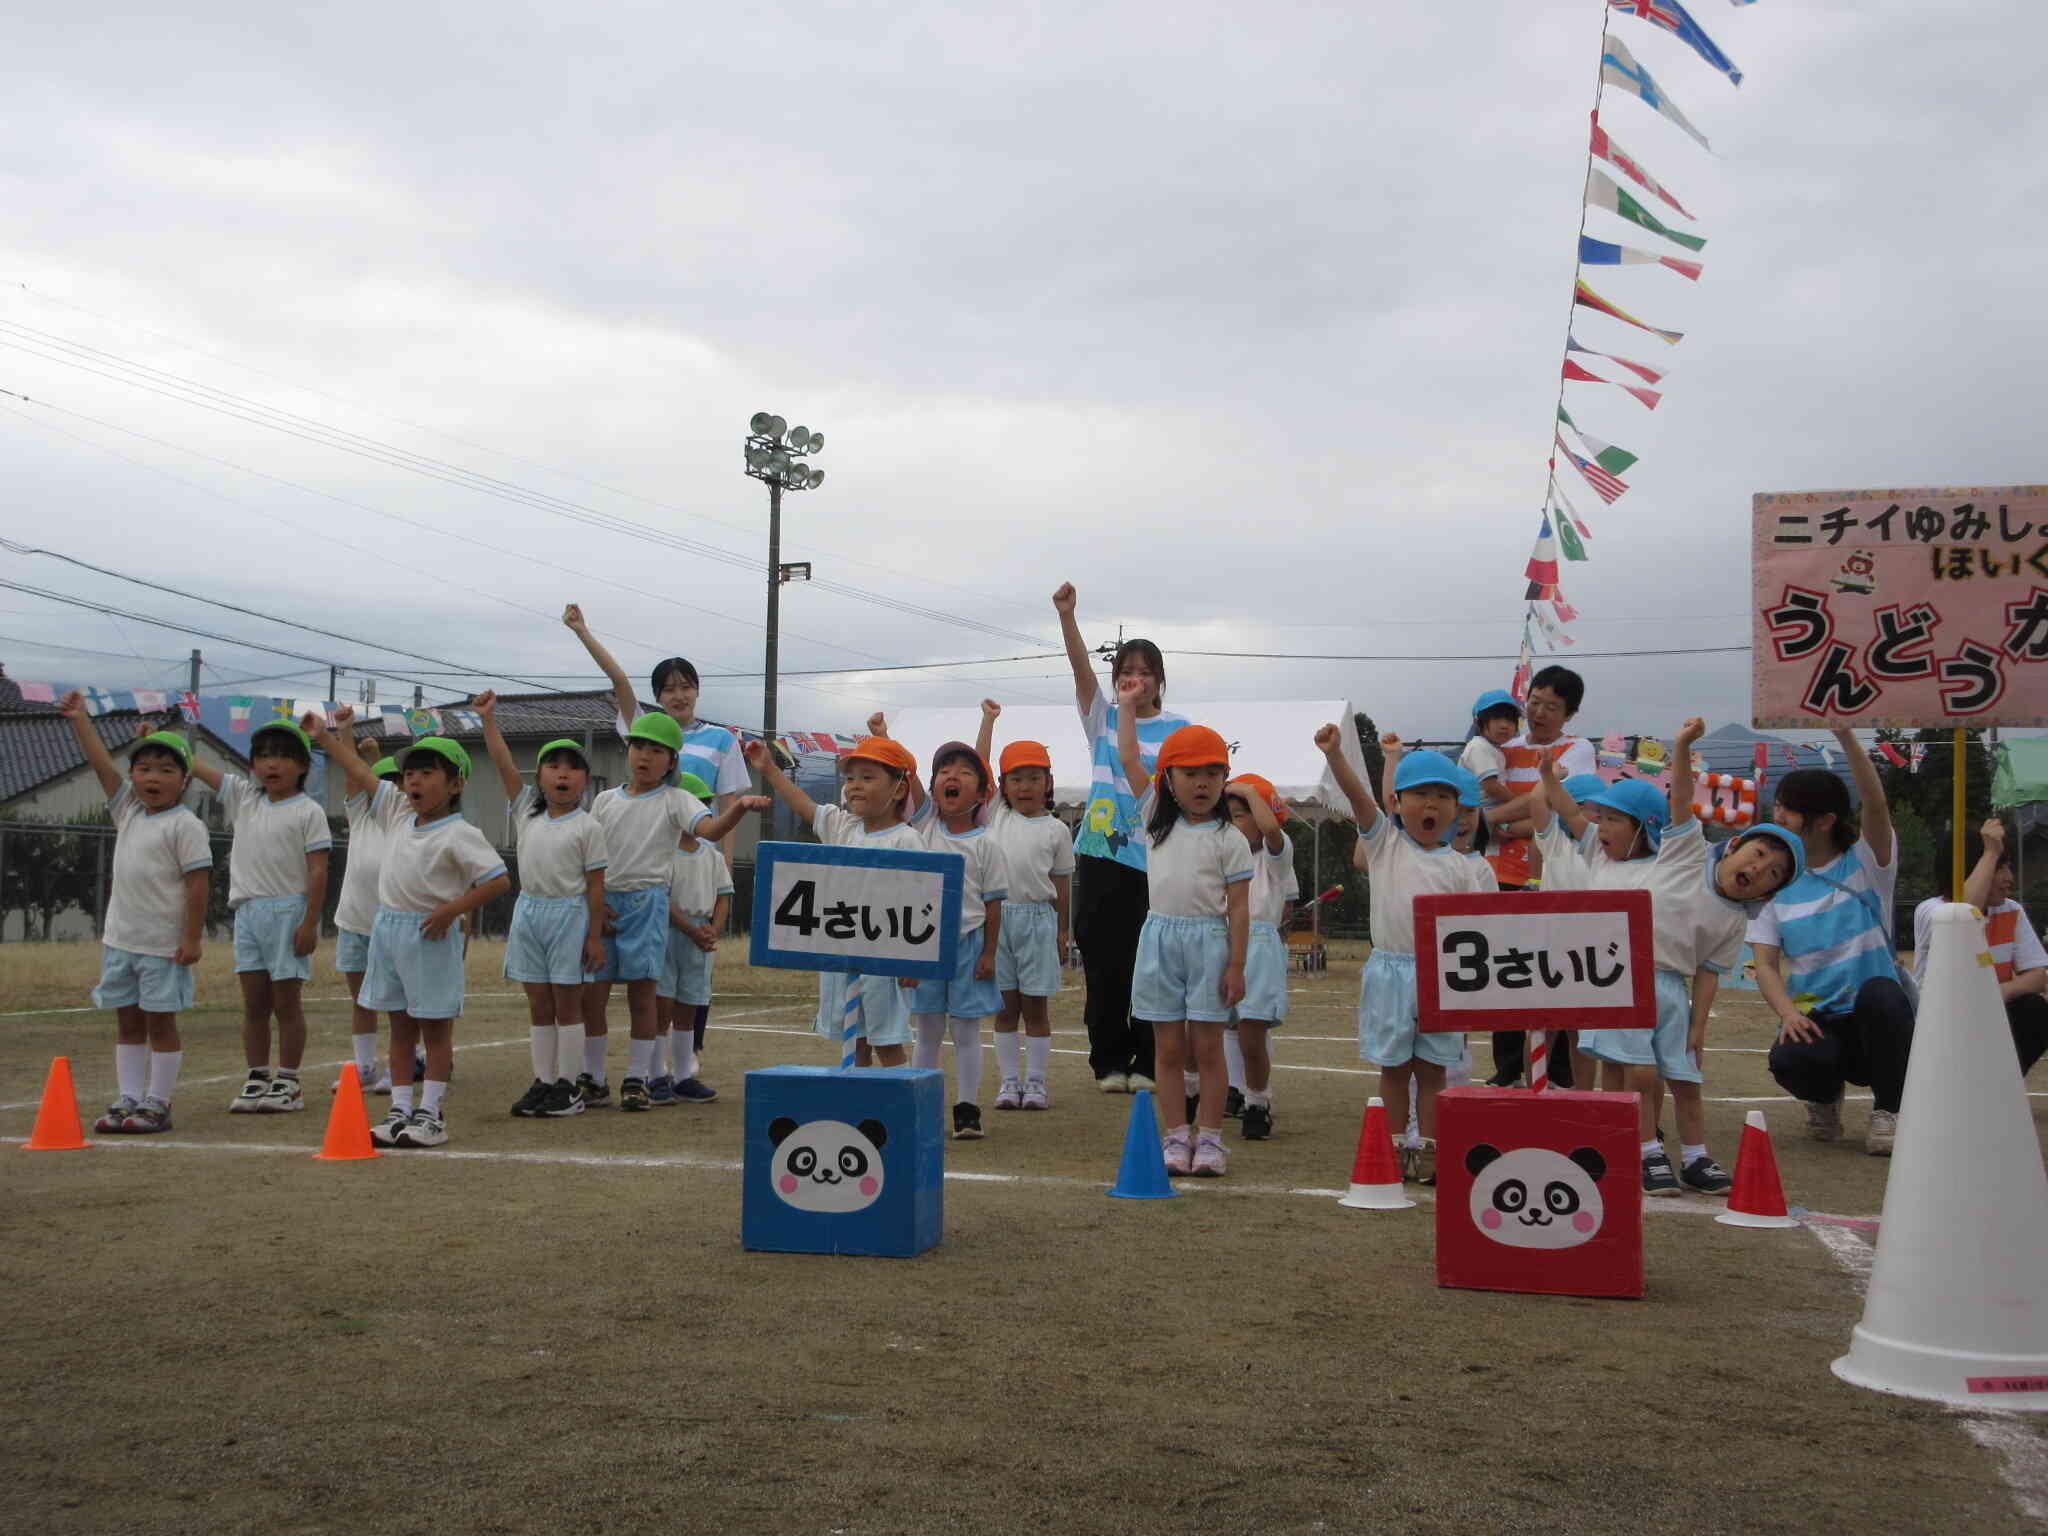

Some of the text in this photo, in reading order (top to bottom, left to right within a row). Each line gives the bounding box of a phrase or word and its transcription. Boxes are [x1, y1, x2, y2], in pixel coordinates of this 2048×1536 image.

[774, 880, 936, 945] 4さいじ
[1442, 930, 1625, 992] 3さいじ
